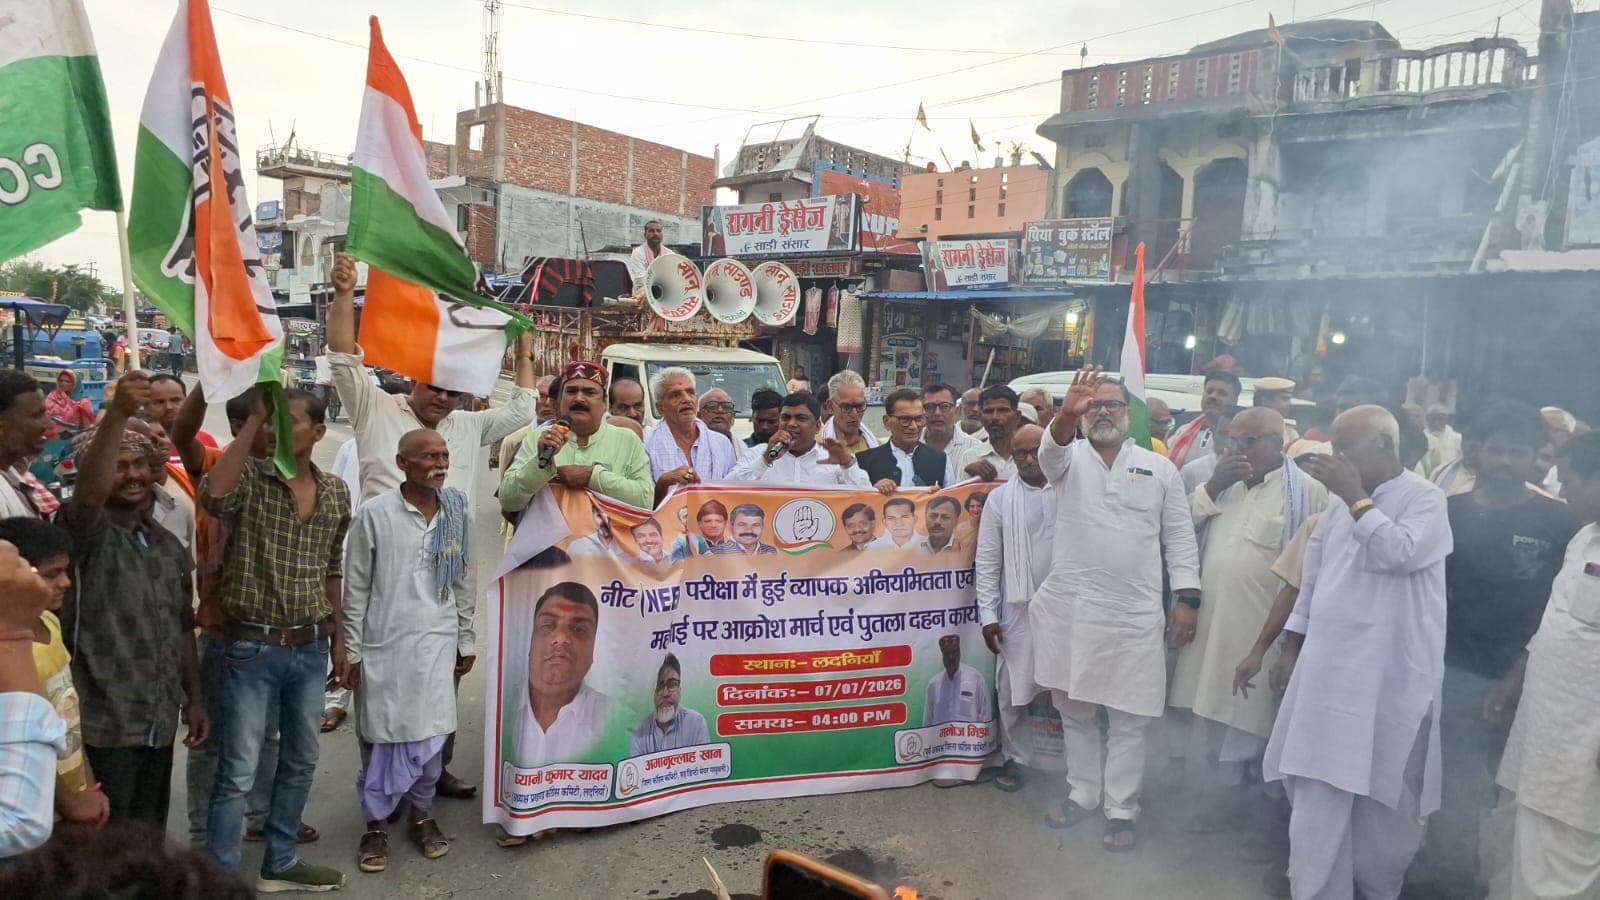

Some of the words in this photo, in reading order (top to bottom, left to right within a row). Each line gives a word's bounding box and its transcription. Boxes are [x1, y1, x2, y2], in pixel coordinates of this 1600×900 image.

[1027, 228, 1054, 242] प्रिया
[1058, 227, 1079, 246] बुक
[1081, 224, 1112, 241] स्टॉल
[781, 237, 811, 251] संसार
[600, 580, 638, 608] नीट
[686, 574, 739, 600] परीक्षा
[742, 572, 758, 599] में
[761, 572, 787, 606] हुई
[789, 577, 849, 597] व्यापक
[853, 567, 952, 595] अनियमितता
[693, 620, 719, 640] पर
[721, 614, 786, 642] आक्रोश
[789, 609, 825, 637] मार्च
[827, 608, 854, 636] एवं
[857, 611, 906, 641] पुतला
[909, 609, 946, 629] दहन
[814, 679, 902, 697] 07/07/2026
[812, 711, 858, 726] 04:00
[863, 709, 891, 722] PM
[699, 748, 723, 761] खान
[545, 768, 576, 784] कुमार
[578, 769, 609, 781] यादव
